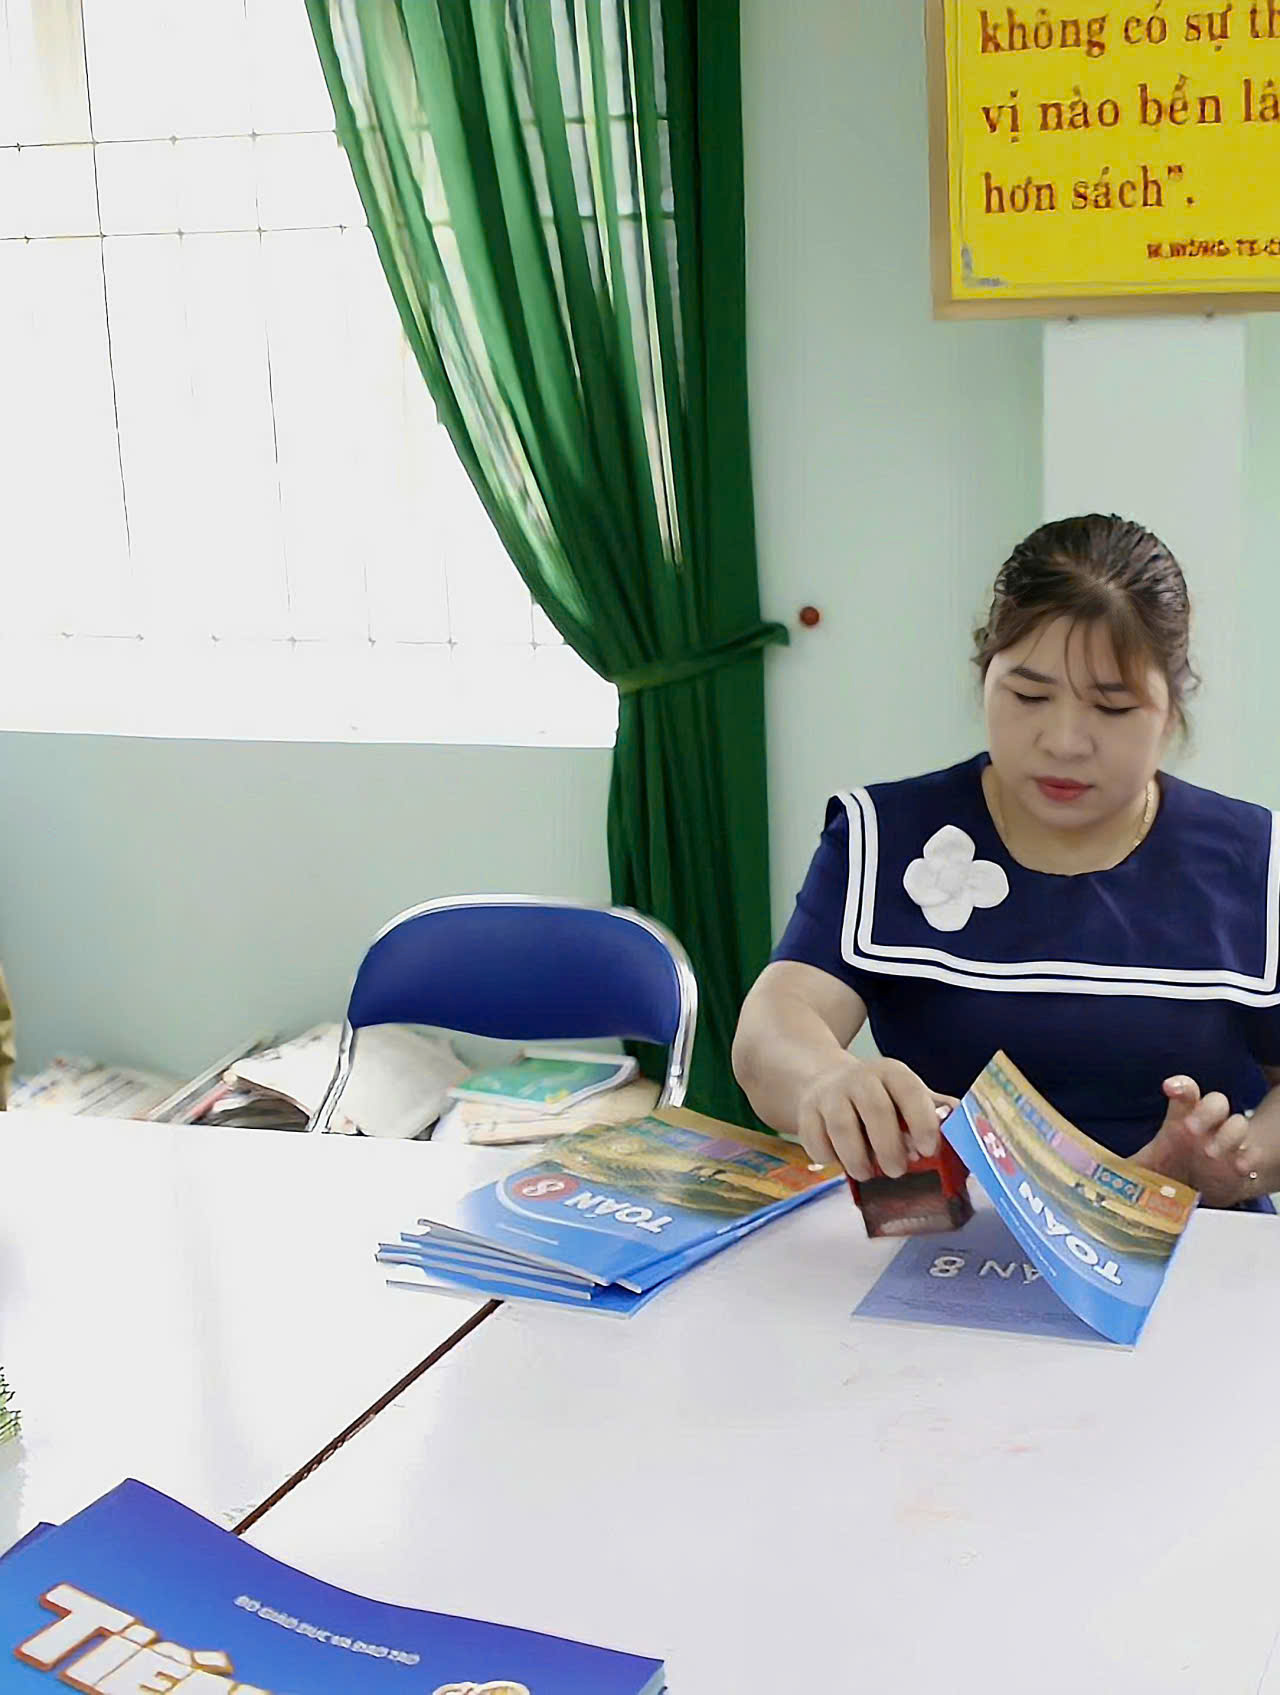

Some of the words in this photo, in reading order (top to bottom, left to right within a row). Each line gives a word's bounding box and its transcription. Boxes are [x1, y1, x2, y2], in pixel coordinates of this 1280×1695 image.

[979, 8, 1109, 58] không
[1123, 0, 1167, 44] có
[1184, 2, 1232, 52] sự
[981, 89, 1021, 143] vị
[1038, 84, 1120, 132] nào
[984, 171, 1056, 214] hơn
[563, 1191, 673, 1234] TOÁN
[929, 1255, 965, 1278] 8
